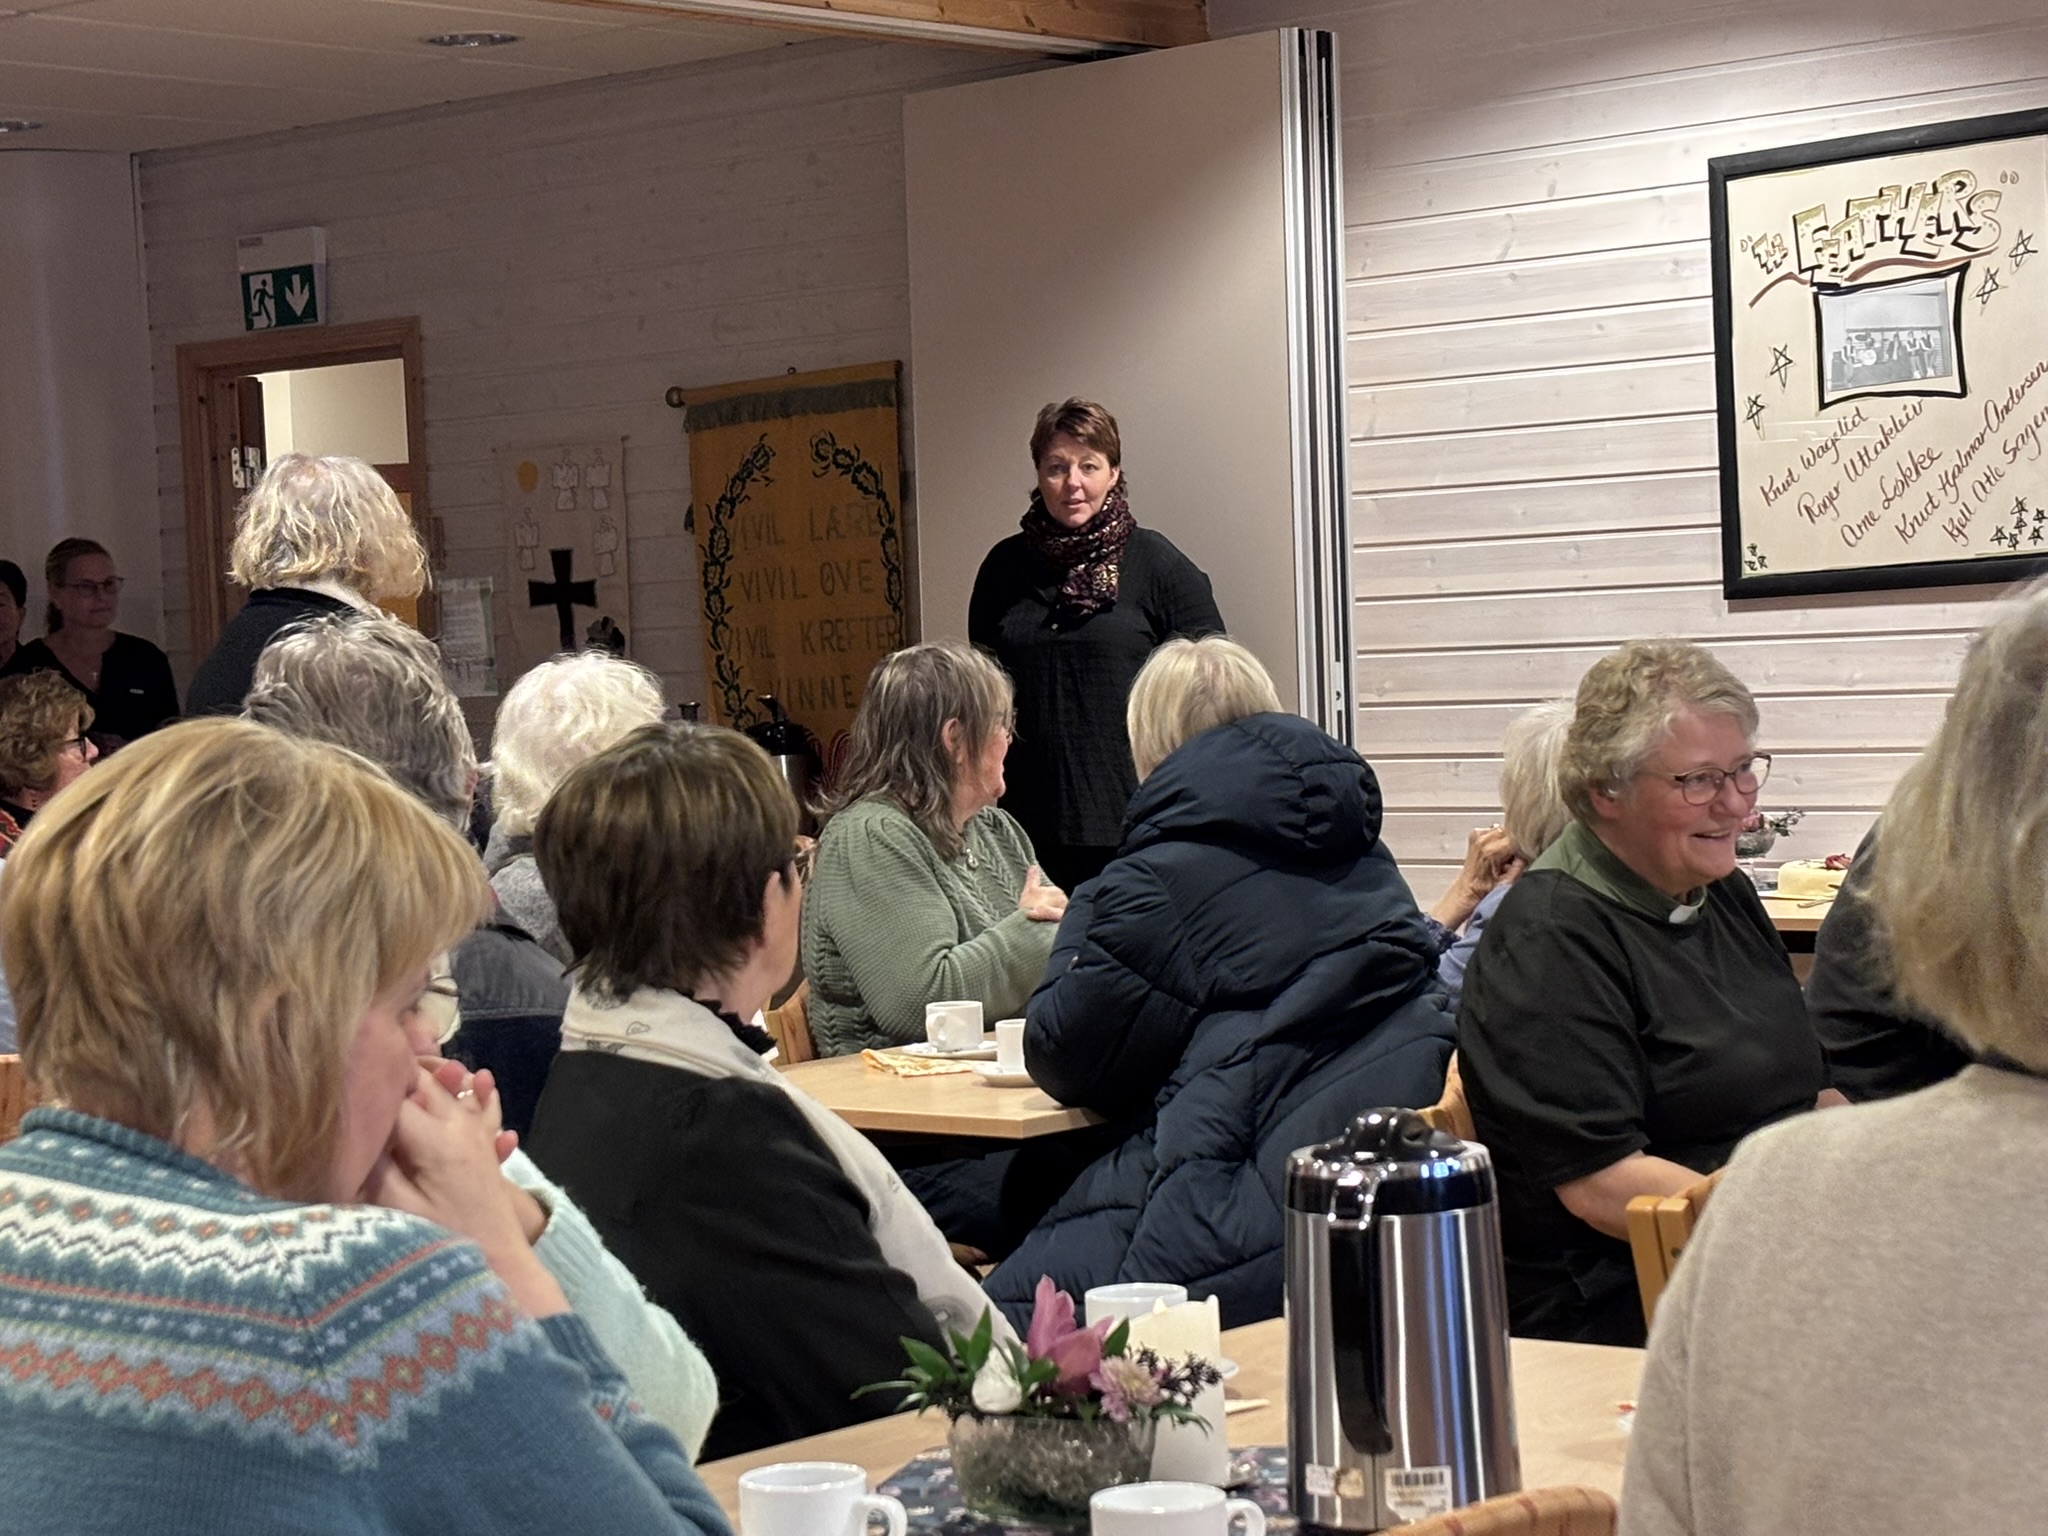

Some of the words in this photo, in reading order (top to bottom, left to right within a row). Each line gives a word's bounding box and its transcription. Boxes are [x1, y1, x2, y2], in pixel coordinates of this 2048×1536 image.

[1894, 491, 1940, 544] Knut
[1938, 425, 1988, 504] Hjalmar
[1984, 361, 2048, 433] Andersen
[1760, 467, 1800, 507] Knut
[1797, 481, 1840, 524] Roger
[1942, 501, 1976, 547] Kjell
[1972, 465, 2005, 502] Atle
[1841, 510, 1881, 548] Arne
